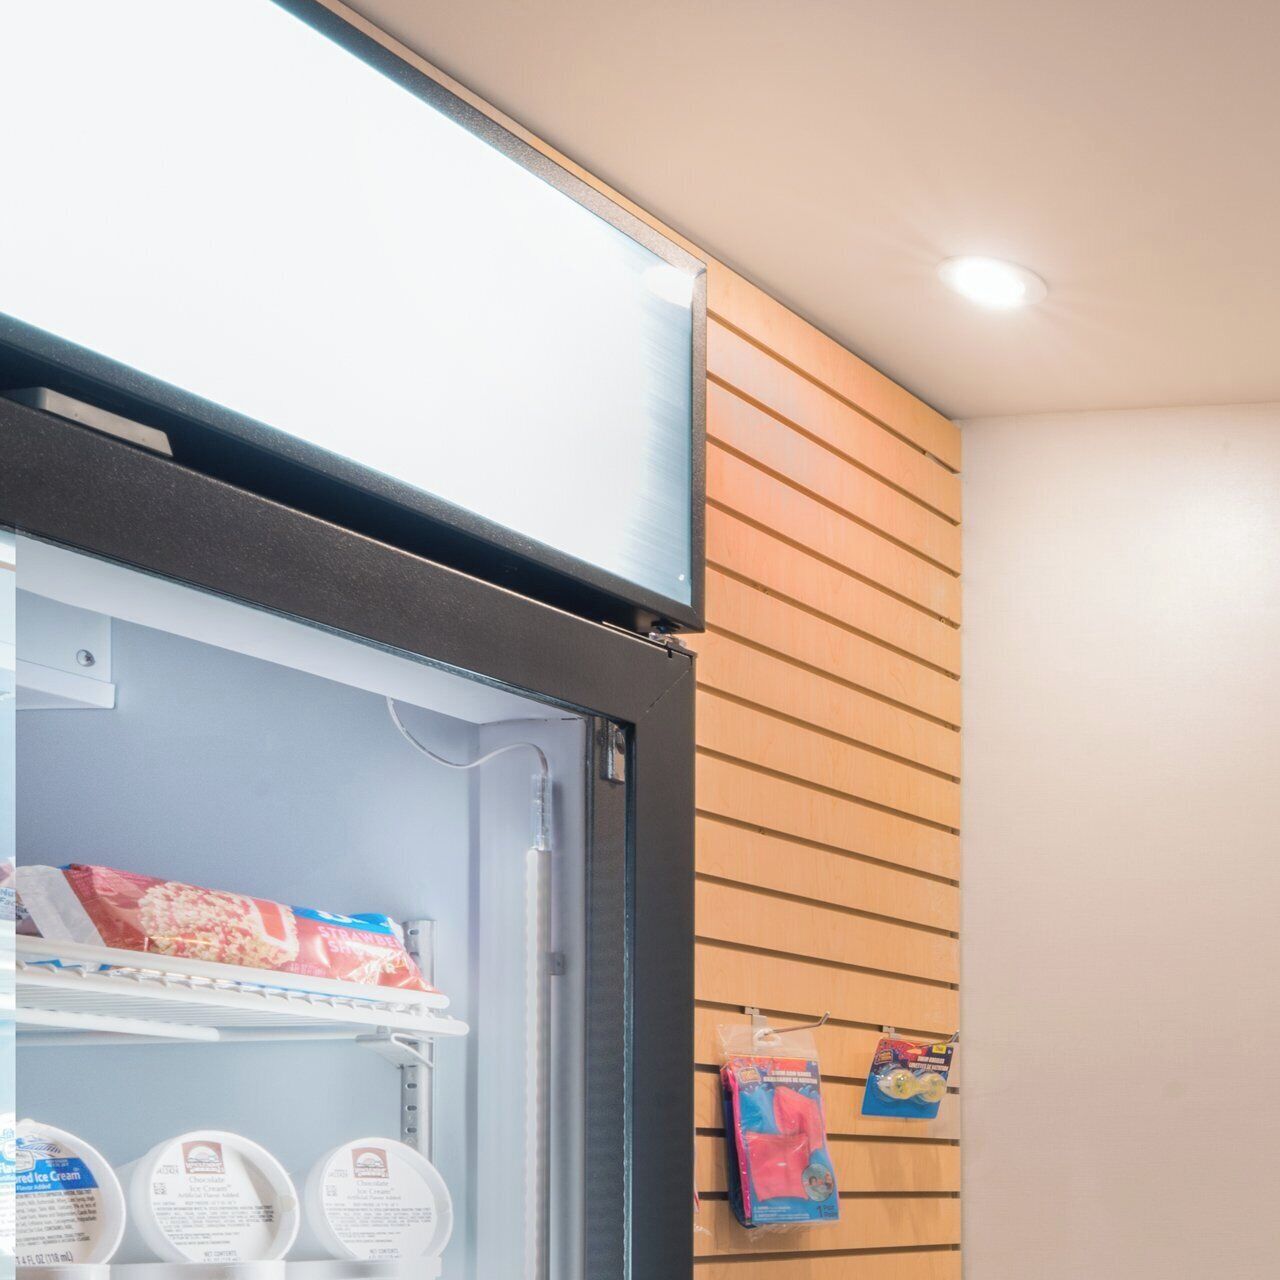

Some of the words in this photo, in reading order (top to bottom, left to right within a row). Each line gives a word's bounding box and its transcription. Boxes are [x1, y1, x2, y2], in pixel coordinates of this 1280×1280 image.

[35, 1172, 48, 1182] Ice
[50, 1170, 81, 1182] Cream
[189, 1176, 224, 1184] Chocolate
[34, 1183, 52, 1191] Added
[189, 1184, 201, 1192] Ice
[202, 1184, 228, 1192] Cream
[36, 1254, 46, 1265] OZ
[60, 1250, 74, 1263] mL)
